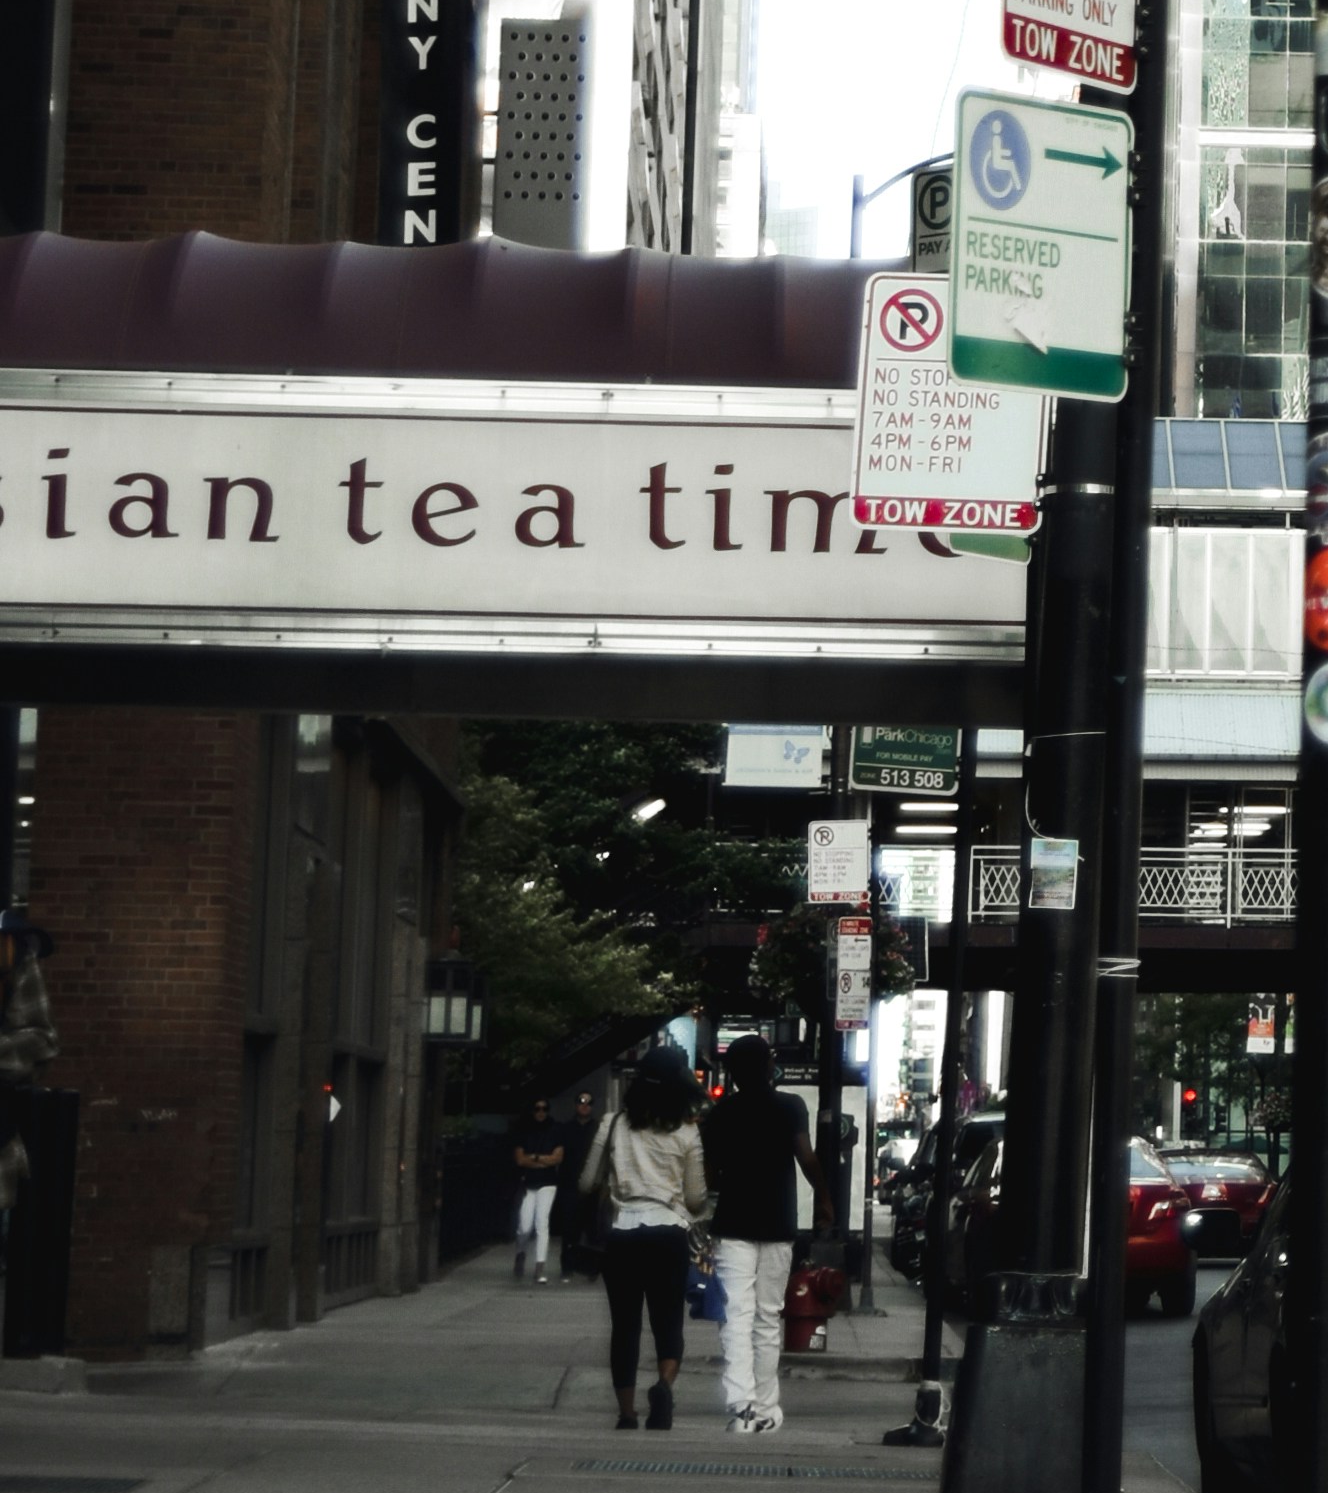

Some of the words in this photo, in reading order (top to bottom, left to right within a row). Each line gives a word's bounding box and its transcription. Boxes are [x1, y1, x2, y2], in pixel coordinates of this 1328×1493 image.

[1011, 17, 1058, 64] TOW
[1069, 34, 1125, 83] ZONE
[918, 240, 945, 257] PAY
[966, 230, 1062, 269] RESERVED
[874, 367, 900, 386] NO
[872, 388, 898, 407] NO
[908, 390, 1001, 411] STANDING
[0, 447, 281, 545] ian
[338, 456, 587, 552] tea
[640, 461, 965, 561] tim
[865, 498, 927, 524] TOW
[942, 501, 1022, 527] ZONE
[875, 751, 891, 760] FOR
[919, 755, 934, 763] PAY
[880, 768, 910, 786] 513
[914, 770, 944, 789] 508
